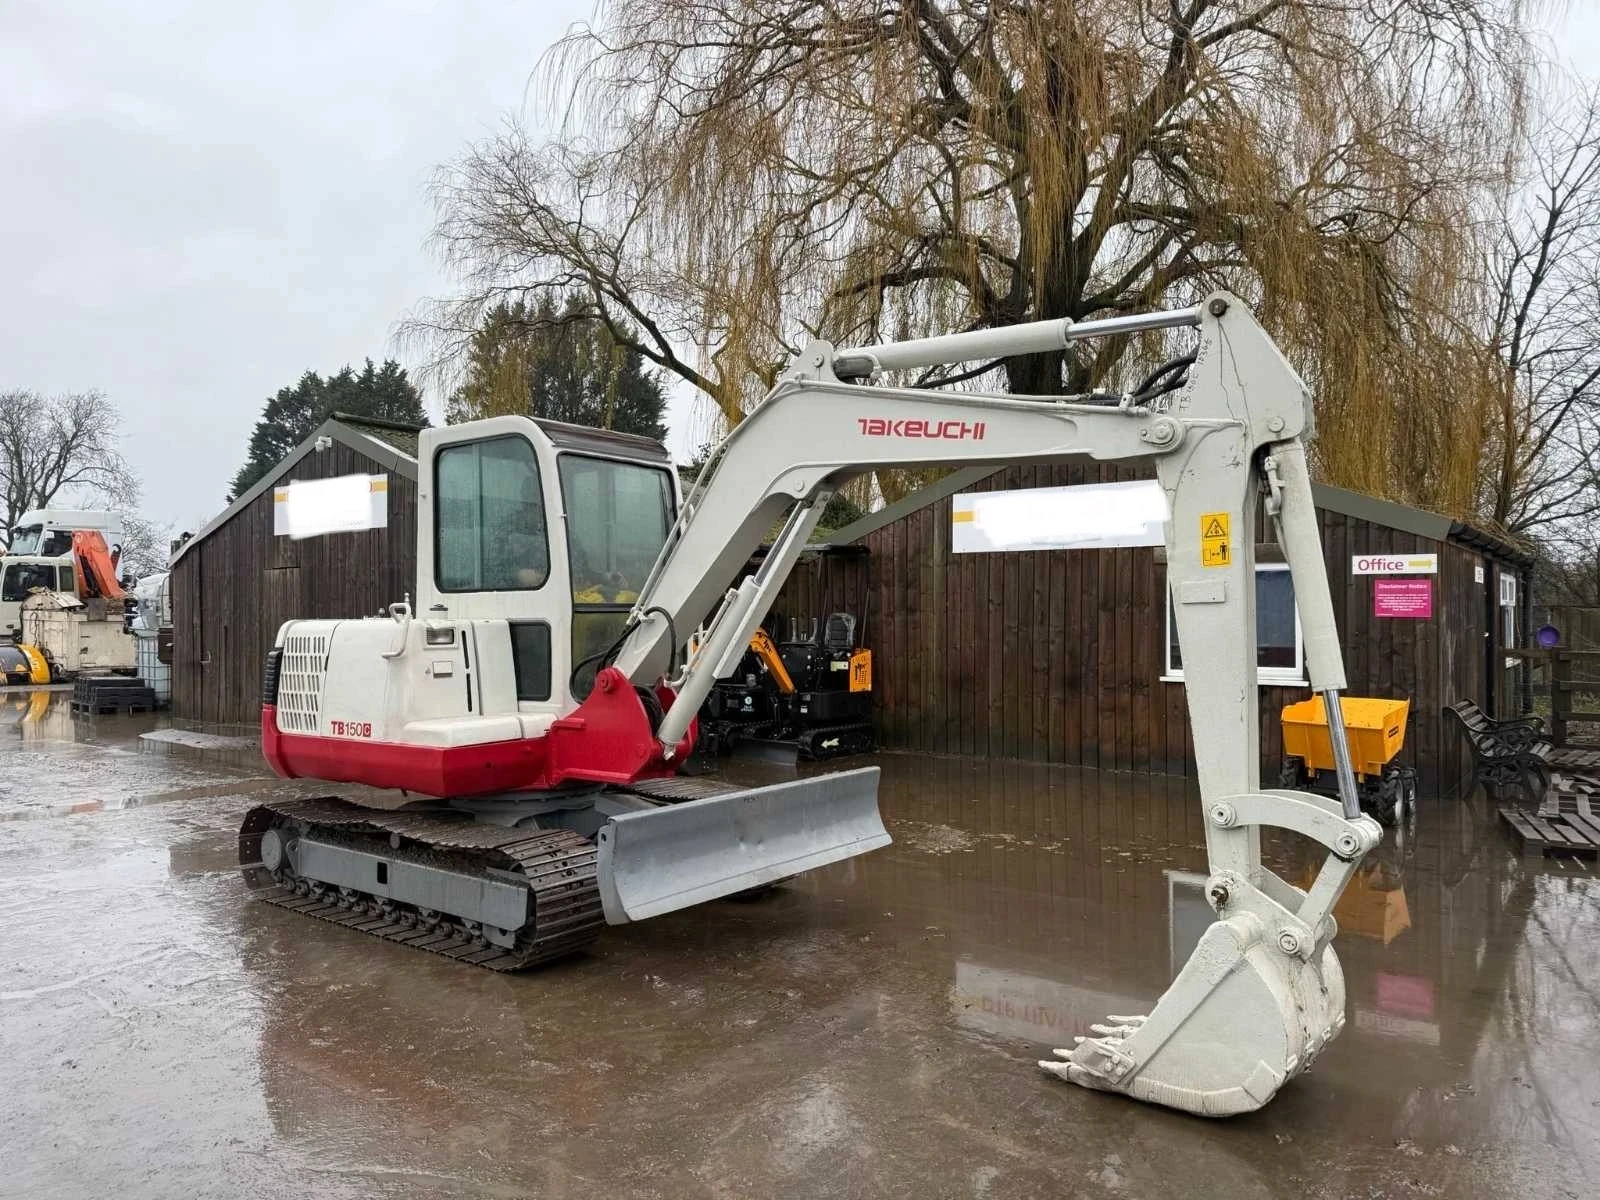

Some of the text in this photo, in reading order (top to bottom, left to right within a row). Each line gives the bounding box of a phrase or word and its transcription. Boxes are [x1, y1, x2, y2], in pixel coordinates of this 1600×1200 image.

[858, 418, 985, 440] TAKEUCHI
[1358, 559, 1404, 571] Office
[331, 720, 371, 737] TB150C
